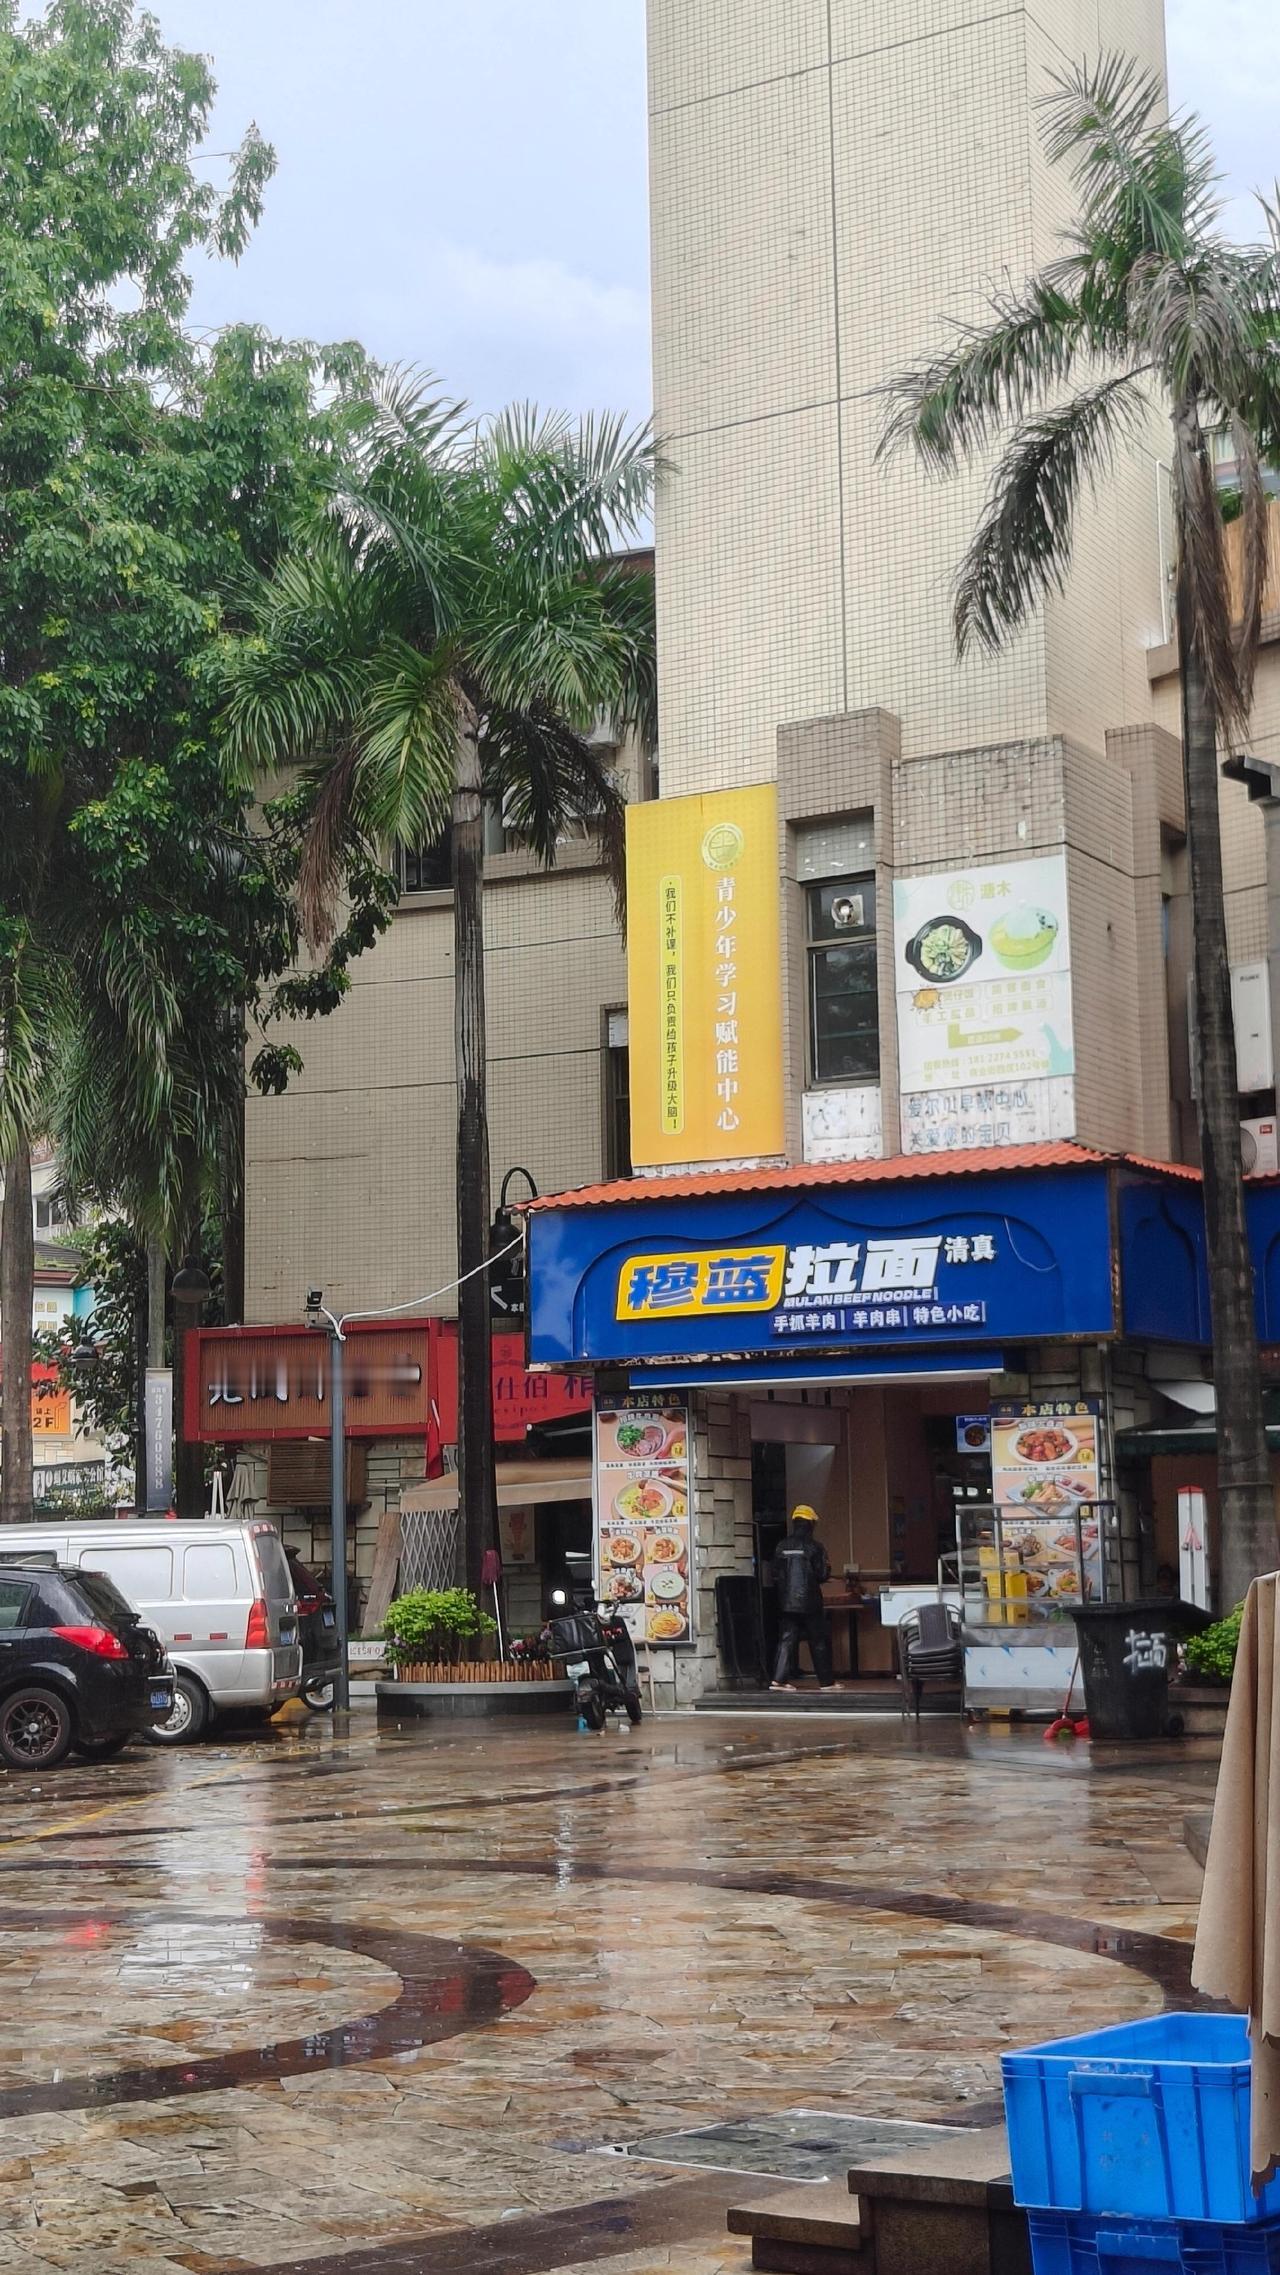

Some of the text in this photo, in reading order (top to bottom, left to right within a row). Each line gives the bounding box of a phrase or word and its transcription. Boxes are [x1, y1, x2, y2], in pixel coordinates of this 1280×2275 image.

[714, 876, 740, 1131] 青少年学习赋能中心
[944, 1234, 996, 1263] 清真
[773, 1303, 980, 1332] 手抓羊肉 羊肉串 特色小吃
[622, 1393, 681, 1408] 本店特色
[1021, 1402, 1090, 1416] 本店特色
[33, 1416, 54, 1428] 2F
